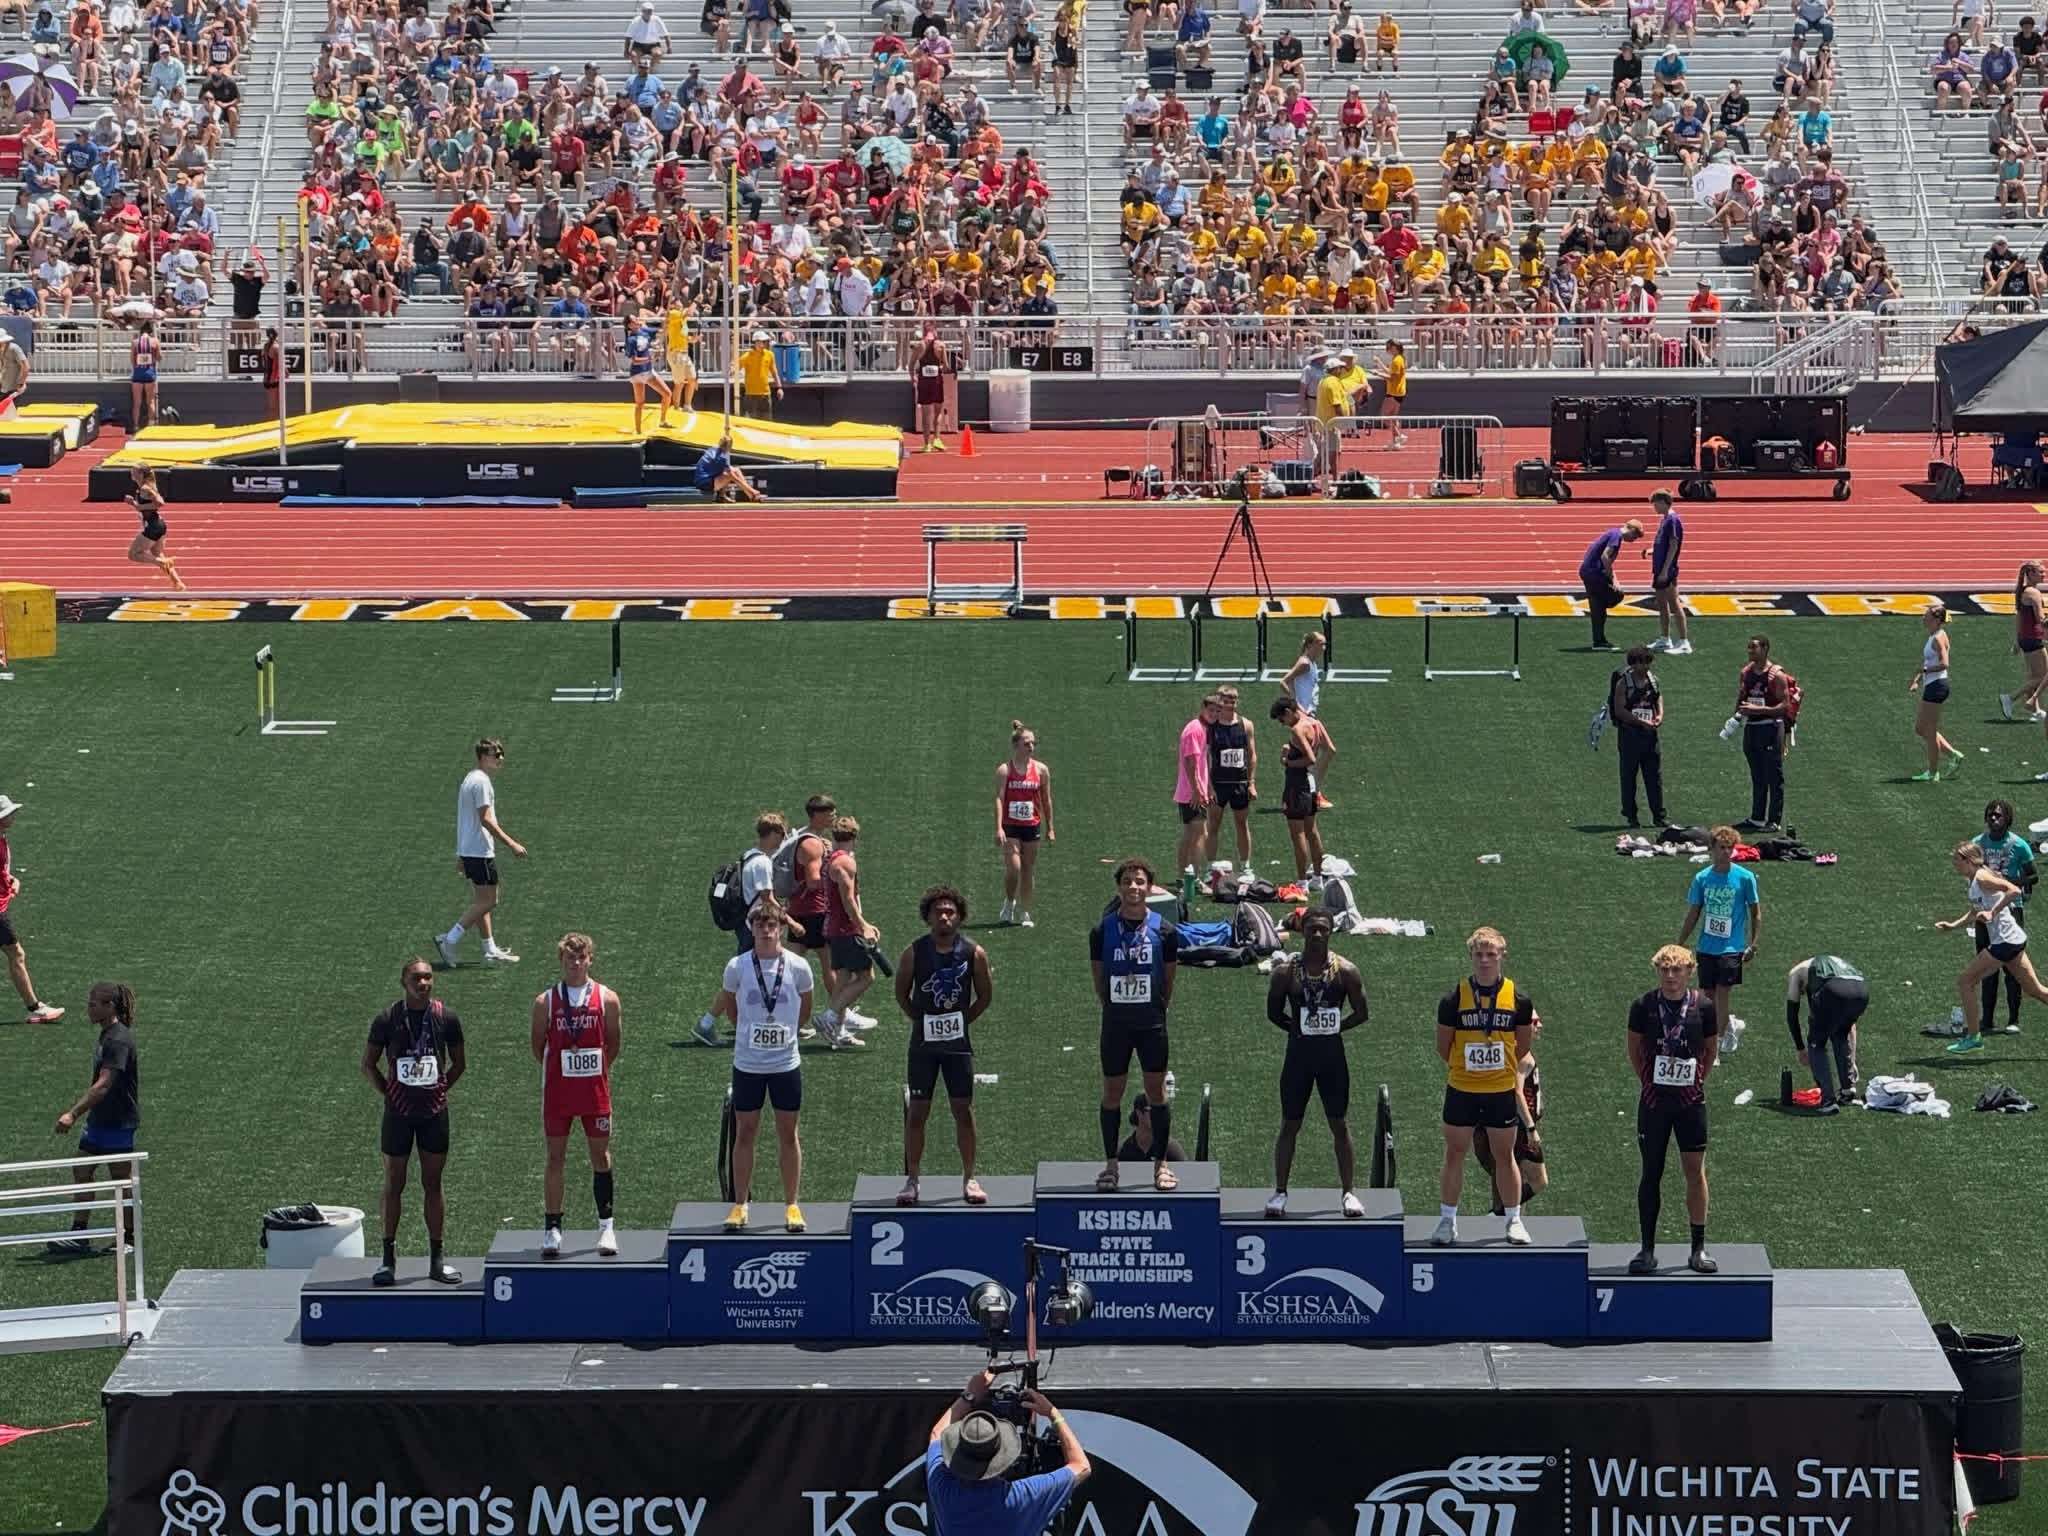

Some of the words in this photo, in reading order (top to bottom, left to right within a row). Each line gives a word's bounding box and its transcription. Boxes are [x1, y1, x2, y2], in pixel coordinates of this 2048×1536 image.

[239, 354, 259, 369] E6
[284, 354, 300, 369] E7
[1022, 352, 1040, 367] E7
[1063, 352, 1082, 367] E8
[467, 463, 519, 476] UCS
[232, 476, 284, 489] UCS
[107, 598, 793, 622] STATE
[1015, 804, 1030, 816] 142
[1709, 919, 1726, 933] 626
[1114, 980, 1147, 996] 4175
[928, 1019, 960, 1036] 1934
[753, 1028, 785, 1045] 2681
[567, 1054, 598, 1071] 1088
[1469, 1048, 1501, 1065] 4348
[1658, 1061, 1692, 1080] 3473
[1078, 1210, 1172, 1231] KSHSAA
[871, 1221, 904, 1266] 2
[1100, 1236, 1153, 1250] STATE
[1070, 1252, 1121, 1267] TRACK
[1124, 1252, 1136, 1267] &
[1139, 1252, 1186, 1267] FIELD
[1236, 1235, 1266, 1276] 3
[679, 1248, 706, 1283] 4
[1412, 1263, 1434, 1293] 5
[493, 1275, 513, 1301] 6
[870, 1292, 972, 1317] KSHSA
[1237, 1292, 1361, 1316] KSHSAA
[1596, 1288, 1614, 1313] 7
[309, 1302, 323, 1319] 8
[726, 1306, 771, 1318] WICHITA
[774, 1306, 805, 1318] STATE
[1158, 1301, 1215, 1323] Mercy
[736, 1318, 797, 1329] UNIVERSITY
[870, 1315, 906, 1325] STATE
[1237, 1314, 1273, 1325] STATE
[1275, 1314, 1371, 1325] CHAMPIONSHIPS
[1588, 1458, 1778, 1499] WICHITA
[1796, 1458, 1921, 1500] STATE
[241, 1482, 514, 1536] Children's
[528, 1485, 707, 1536] Mercy
[1591, 1506, 1851, 1536] UNIVERSITY
